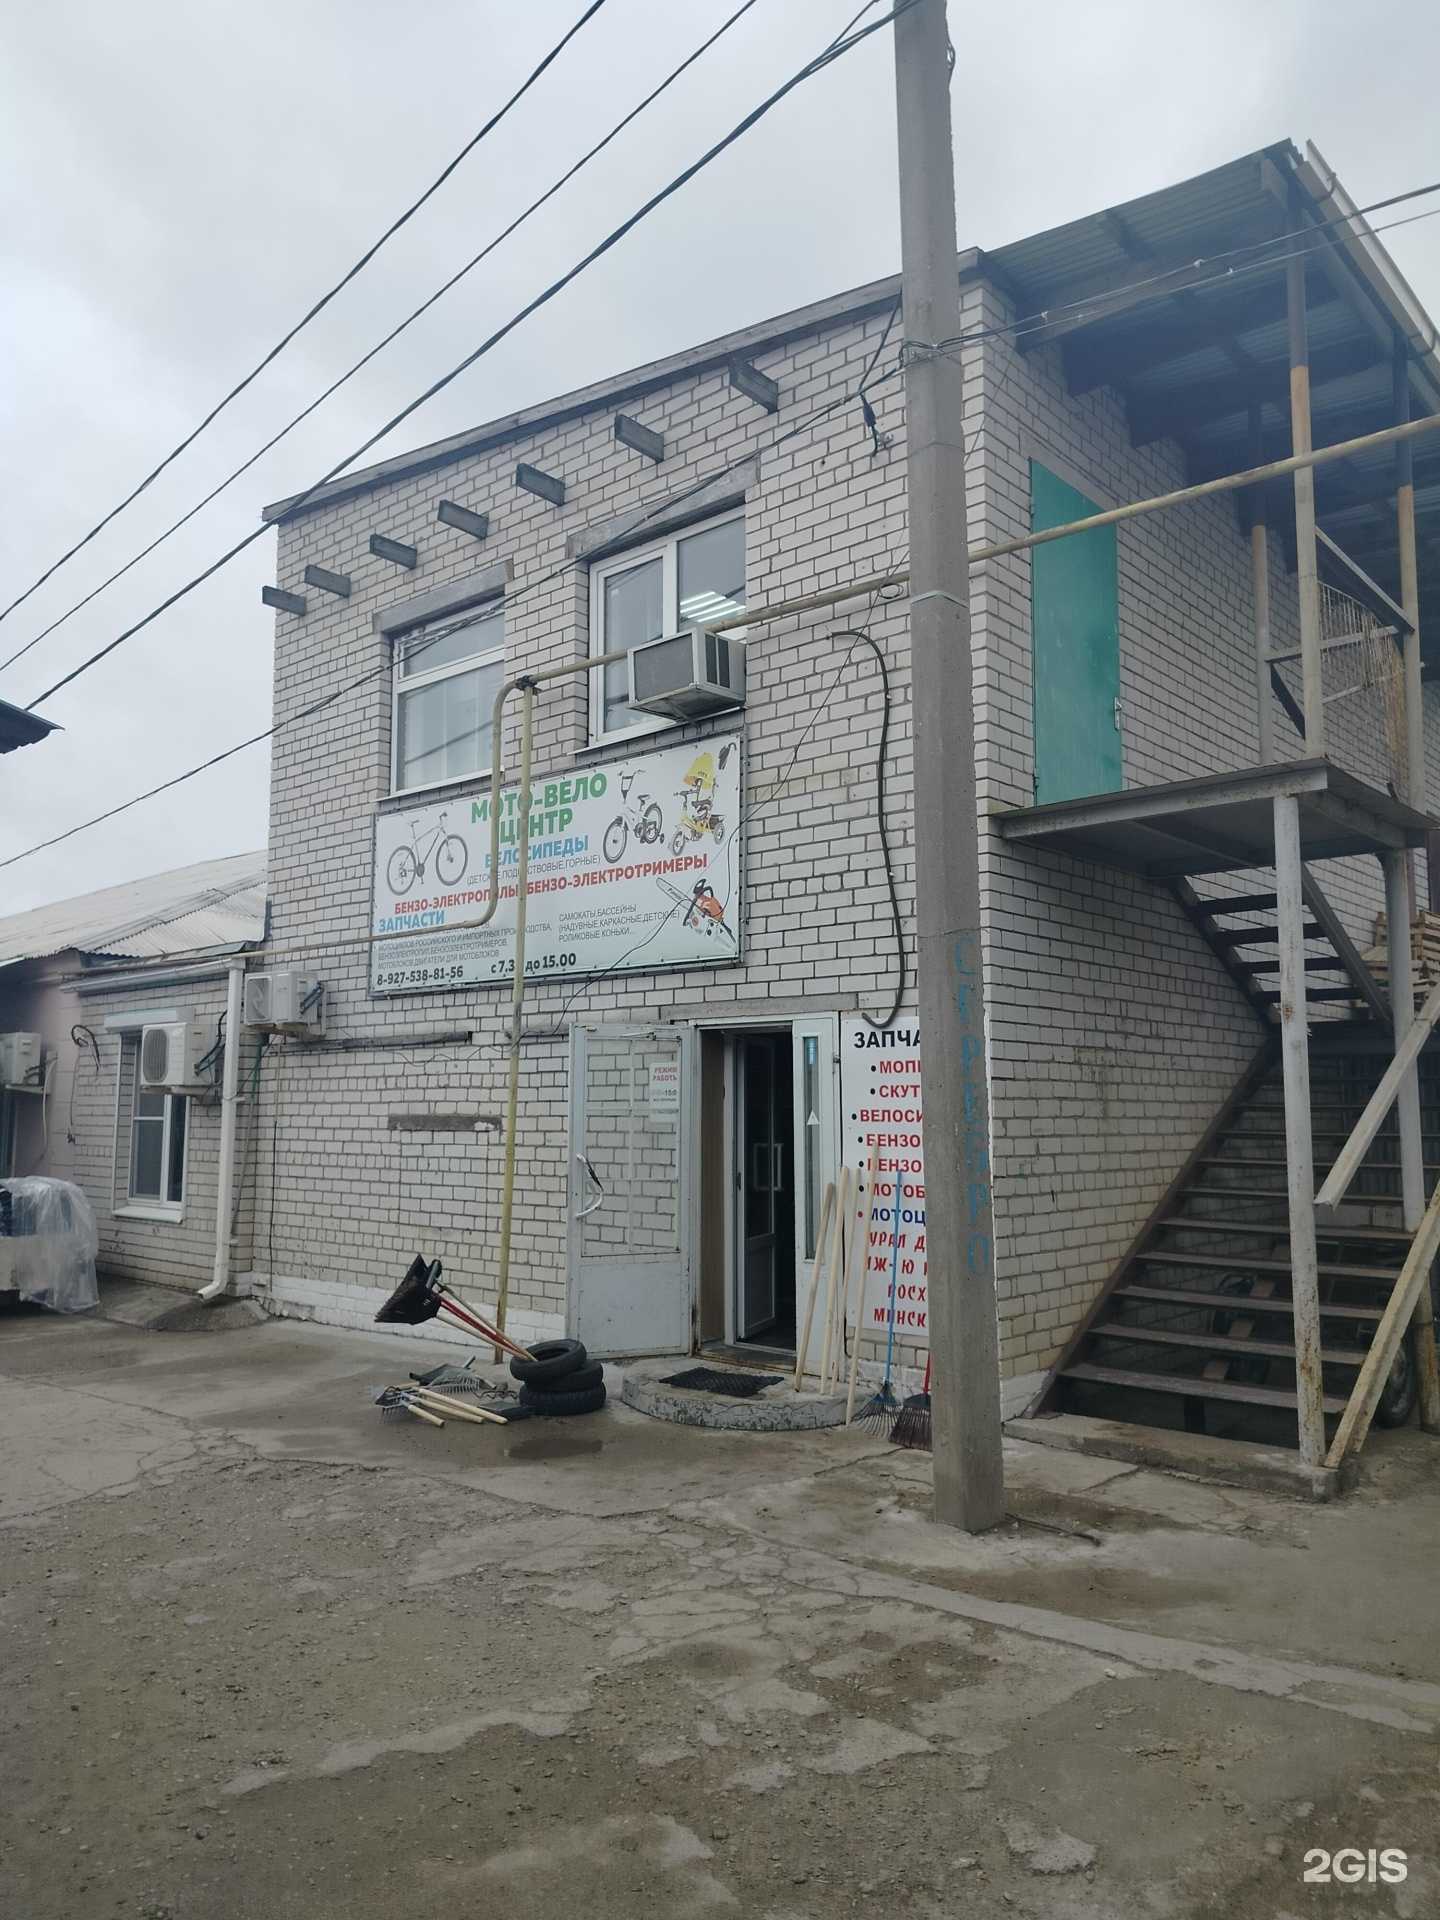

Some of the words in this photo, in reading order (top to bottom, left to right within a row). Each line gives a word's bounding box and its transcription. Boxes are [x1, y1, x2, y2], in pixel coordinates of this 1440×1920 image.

[499, 808, 573, 845] ЦНТР
[395, 884, 518, 914] БЕНЗО-ЭЛЕКТРОПЛЫ
[527, 853, 707, 893] БЕНЗО-ЭЛЕКТРОТРИМЕРЫ
[378, 910, 445, 933] ЗАПЧАСТИ
[525, 960, 540, 972] до
[543, 953, 576, 969] 15.00
[377, 965, 464, 985] 8-927-538-81-56
[880, 1060, 922, 1073] МОП
[867, 1158, 922, 1173] ЕНЗО
